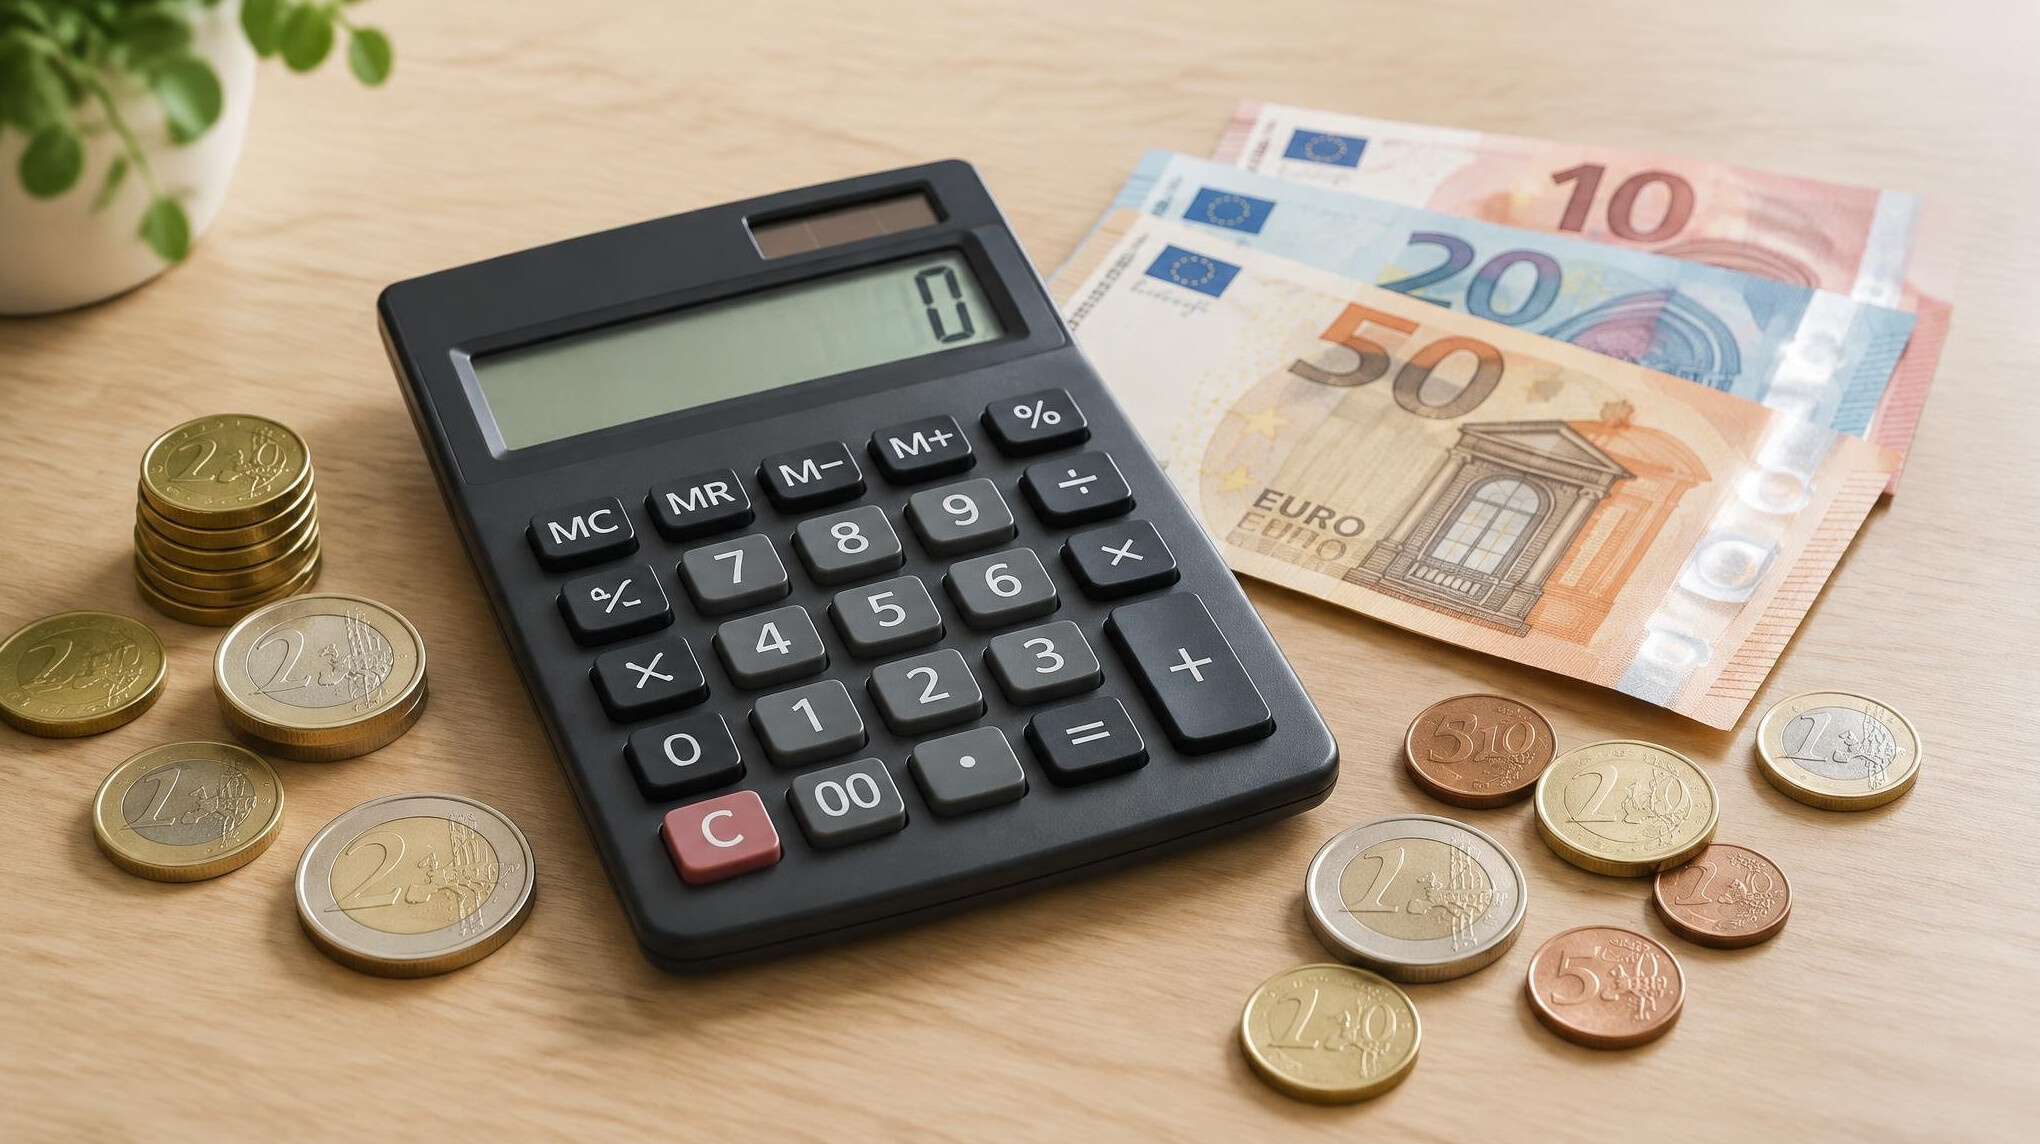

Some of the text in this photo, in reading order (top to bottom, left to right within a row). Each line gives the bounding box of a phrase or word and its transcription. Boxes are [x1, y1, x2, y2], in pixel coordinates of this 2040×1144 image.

[1552, 162, 1694, 243] 10
[1376, 230, 1562, 326] 20
[915, 266, 974, 343] 0
[1289, 302, 1504, 420] 50
[1014, 401, 1060, 428] %
[889, 429, 953, 458] M+
[666, 481, 735, 514] MR
[943, 495, 978, 525] 9
[1253, 488, 1365, 537] EURO
[548, 509, 618, 544] MC
[831, 522, 868, 553] 8
[714, 550, 743, 583] 7
[986, 564, 1021, 597] 6
[868, 592, 905, 626] 5
[756, 622, 791, 654] 4
[1024, 638, 1064, 673] 3
[907, 667, 949, 703] 2
[792, 699, 823, 732] 1
[815, 773, 880, 816] 00
[702, 810, 743, 847] C
[324, 830, 402, 912] 2
[1551, 946, 1600, 1006] 5
